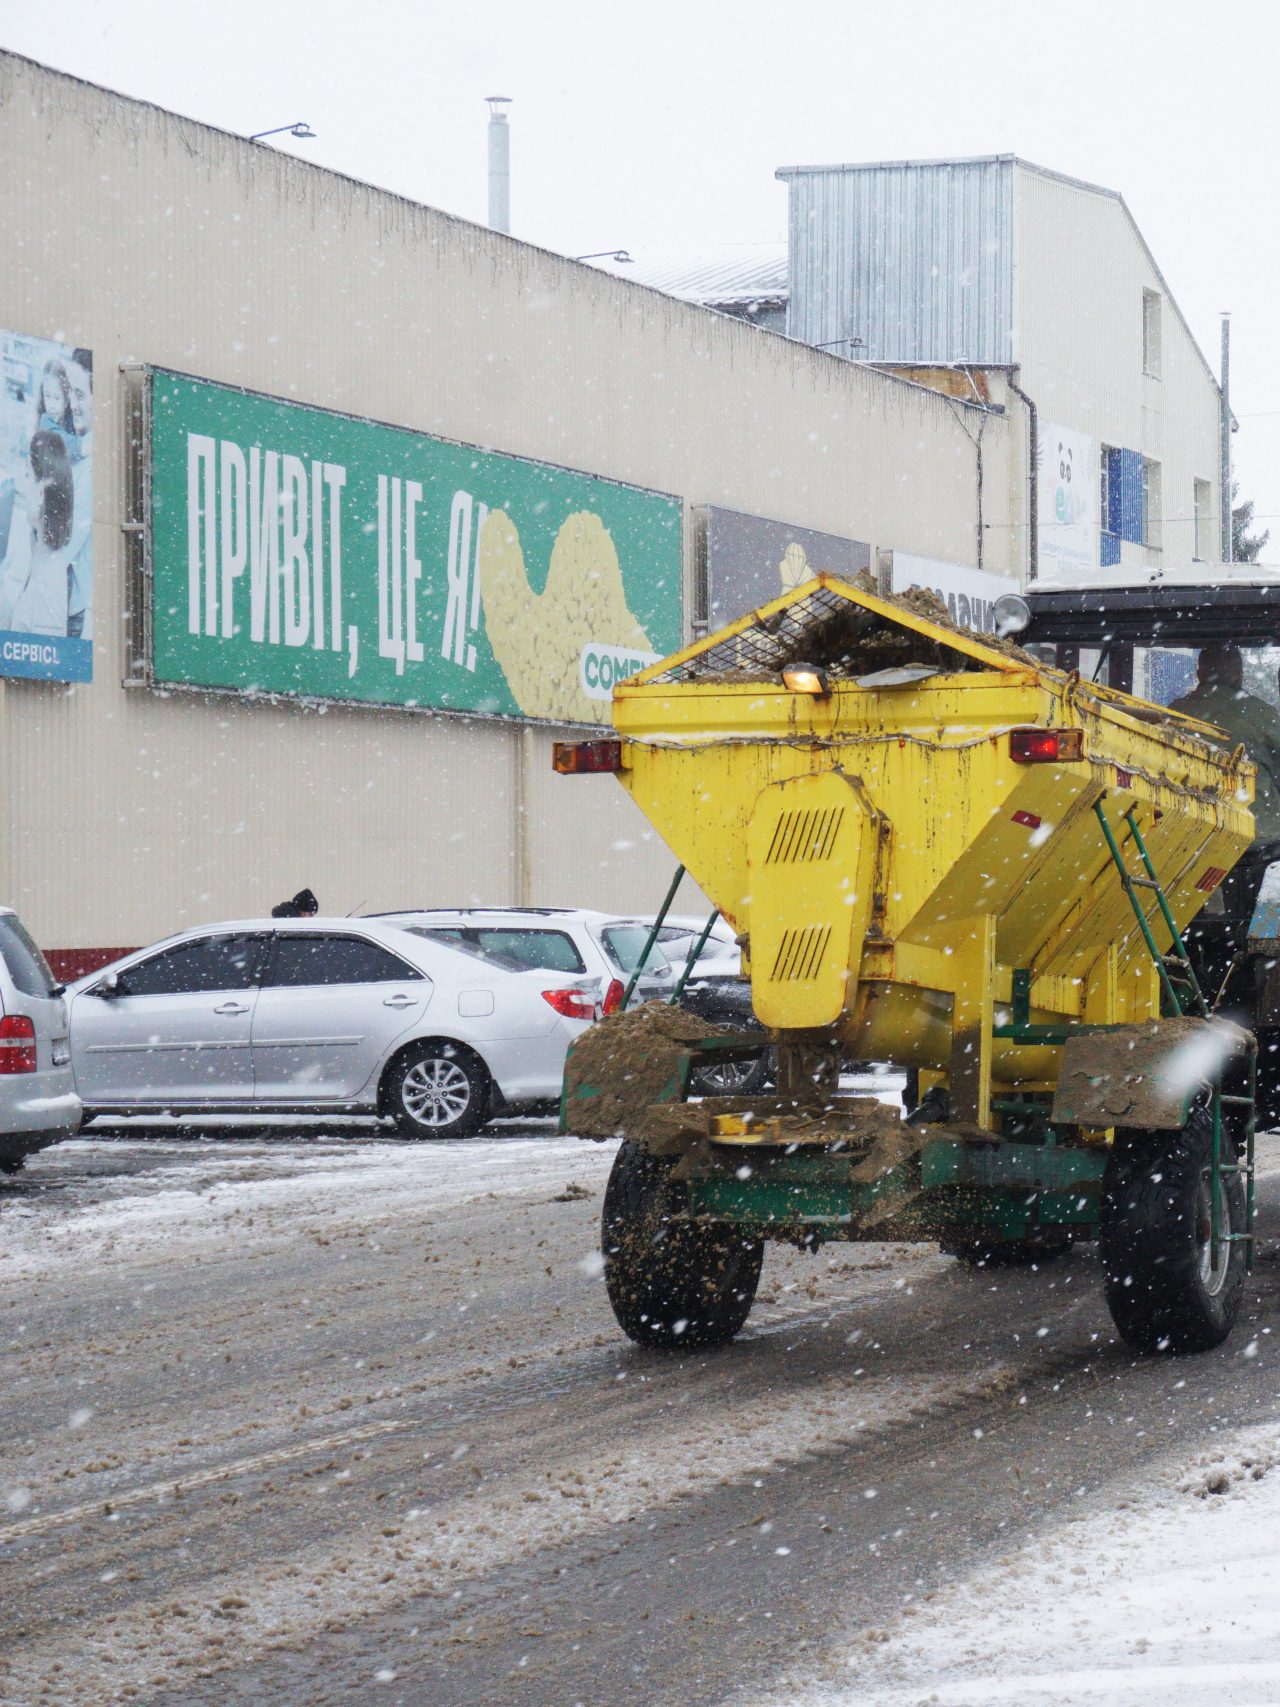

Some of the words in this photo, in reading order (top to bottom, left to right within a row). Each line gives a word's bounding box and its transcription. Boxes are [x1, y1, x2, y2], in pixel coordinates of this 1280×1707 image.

[187, 432, 359, 678] ПРИВІТ,
[377, 474, 425, 676] ЦЕ
[441, 489, 488, 673] Я!
